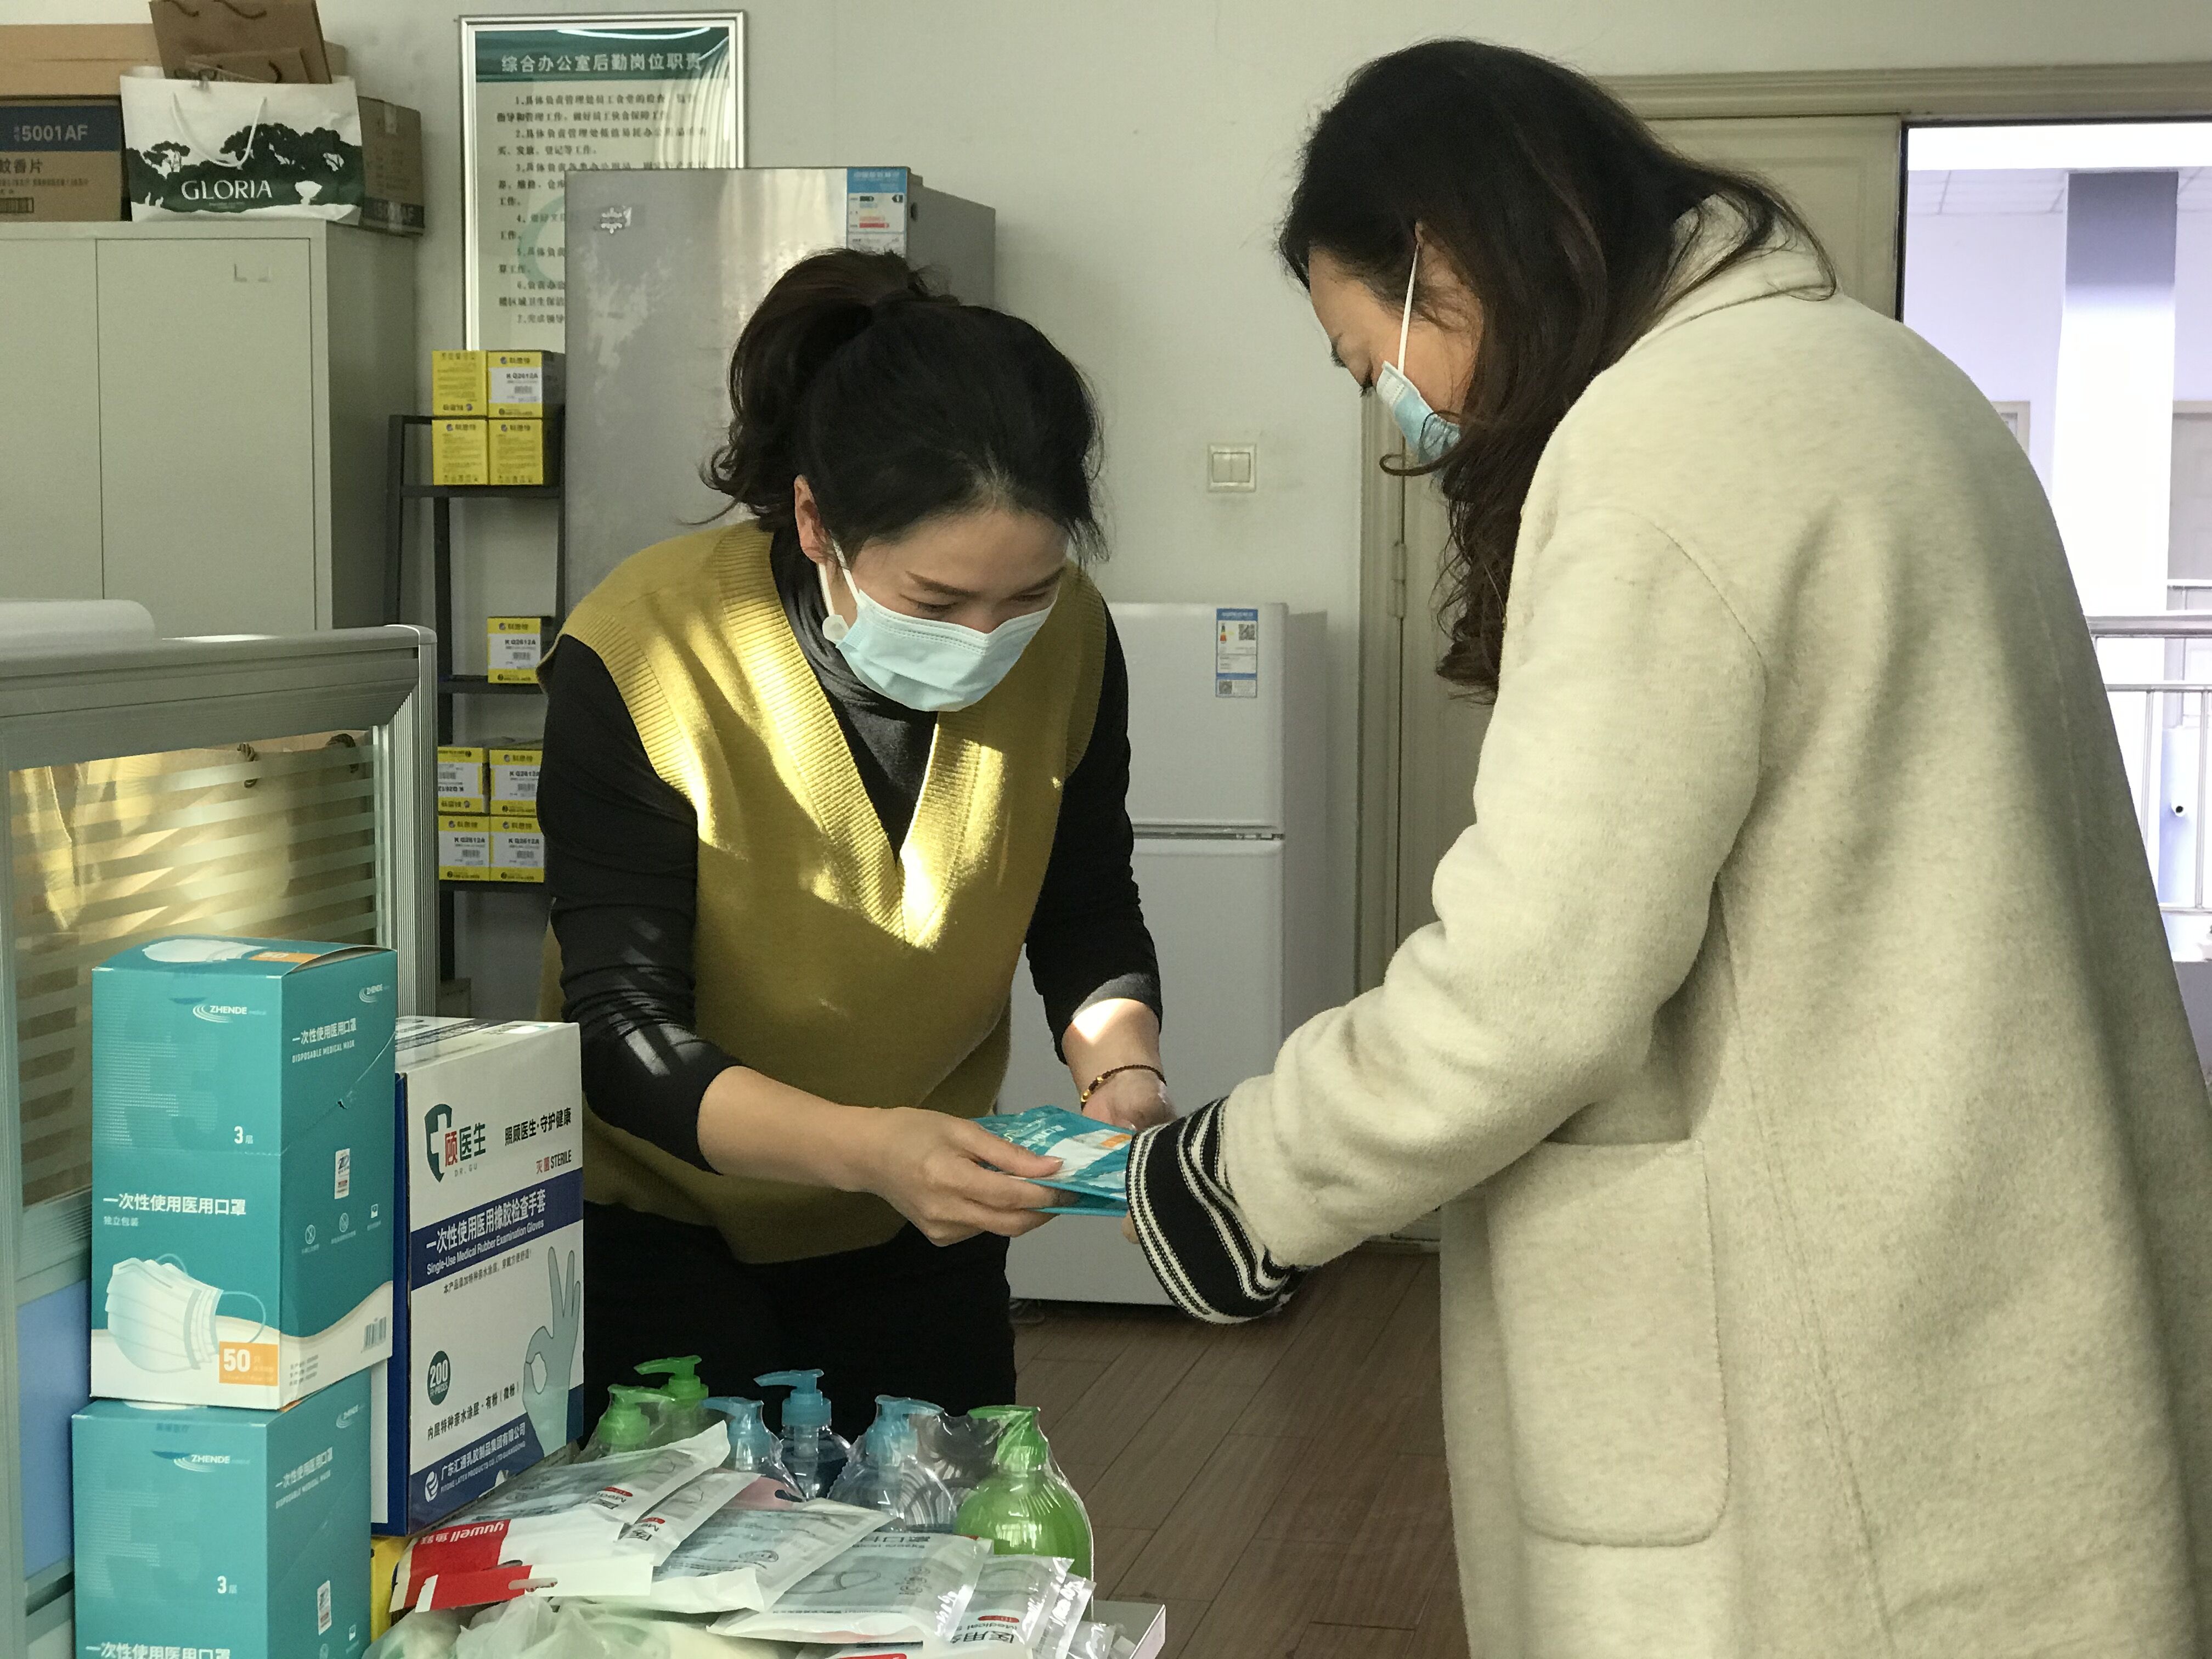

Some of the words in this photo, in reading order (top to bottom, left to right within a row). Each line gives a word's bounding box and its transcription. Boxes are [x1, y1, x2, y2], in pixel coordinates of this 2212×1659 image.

[501, 53, 702, 73] 综合办公室后勤岗位职责
[22, 125, 88, 142] 5001AF
[181, 179, 273, 200] GLORIA
[210, 1005, 247, 1015] ZHENDE
[292, 1018, 357, 1045] 一次性使用医用口罩
[292, 1048, 321, 1063] DISPOSABLE
[234, 1126, 243, 1144] 3
[444, 1122, 486, 1167] 顾医生
[550, 1149, 572, 1169] STERILE
[103, 1193, 246, 1216] 一次性使用医用口罩
[103, 1216, 139, 1227] 独立包装
[426, 1188, 546, 1254] 一次性使用医用橡胶检查手套
[427, 1255, 456, 1276] Single-Use
[456, 1245, 477, 1263] Medical
[477, 1238, 496, 1255] Rubber
[527, 1219, 544, 1234] Gloves
[223, 1348, 251, 1372] 50
[430, 1359, 448, 1389] 200
[191, 1454, 230, 1464] ZHENDE
[449, 1521, 504, 1542] yuwell
[217, 1575, 227, 1594] 3
